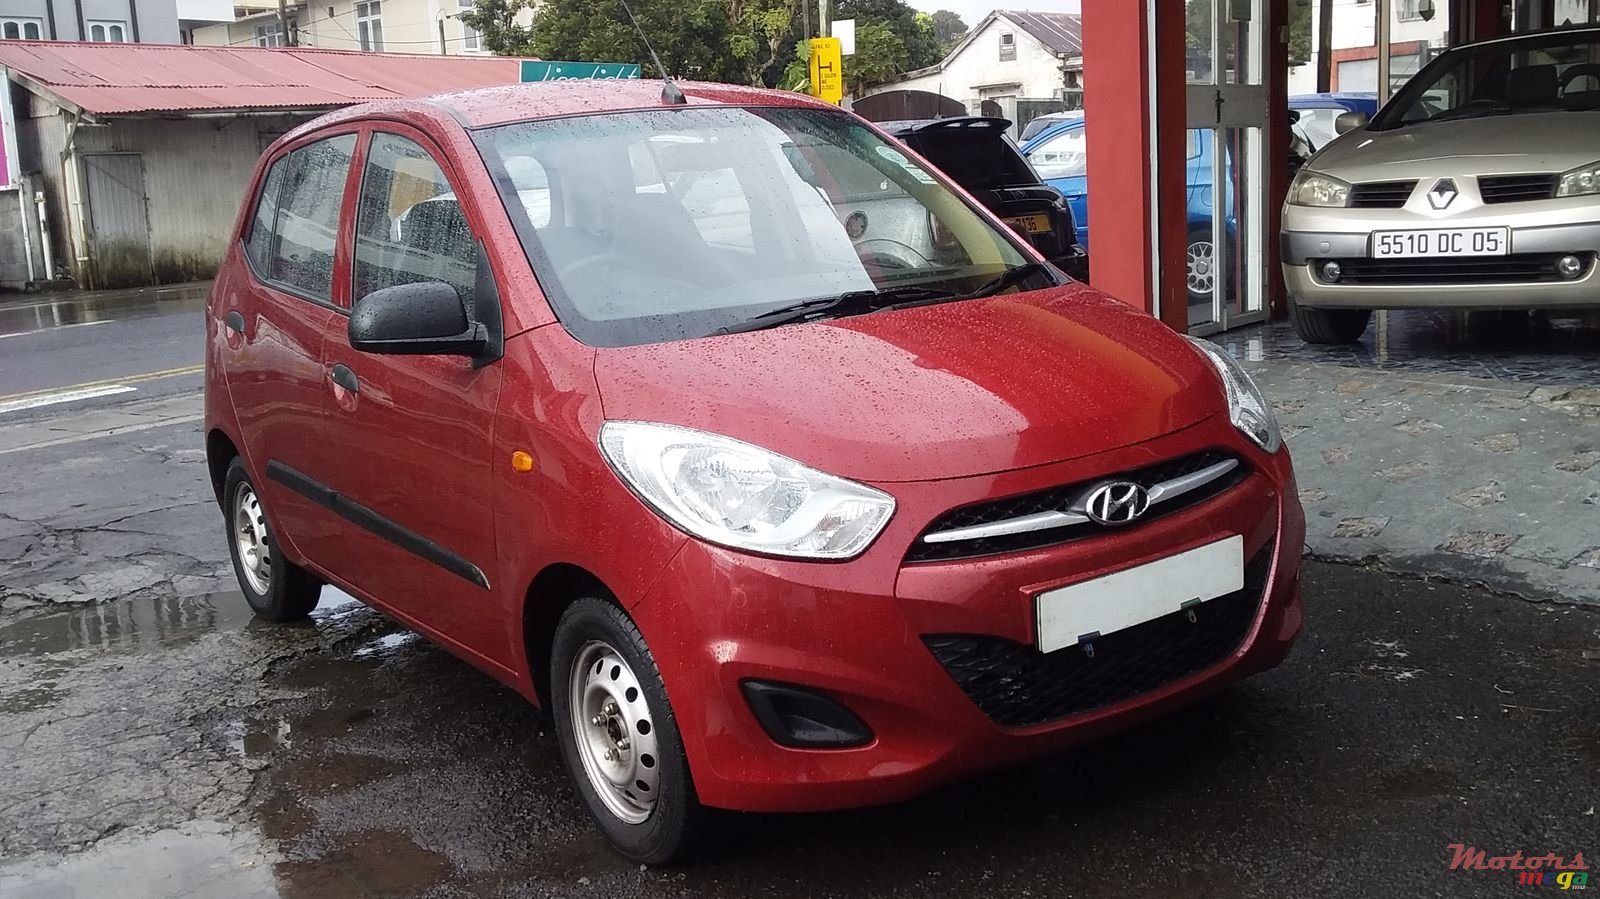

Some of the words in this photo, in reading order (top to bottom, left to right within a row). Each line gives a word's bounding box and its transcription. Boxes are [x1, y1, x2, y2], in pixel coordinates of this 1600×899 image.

[1380, 234, 1428, 254] 5510
[1438, 233, 1463, 253] DC
[1472, 232, 1499, 252] 05
